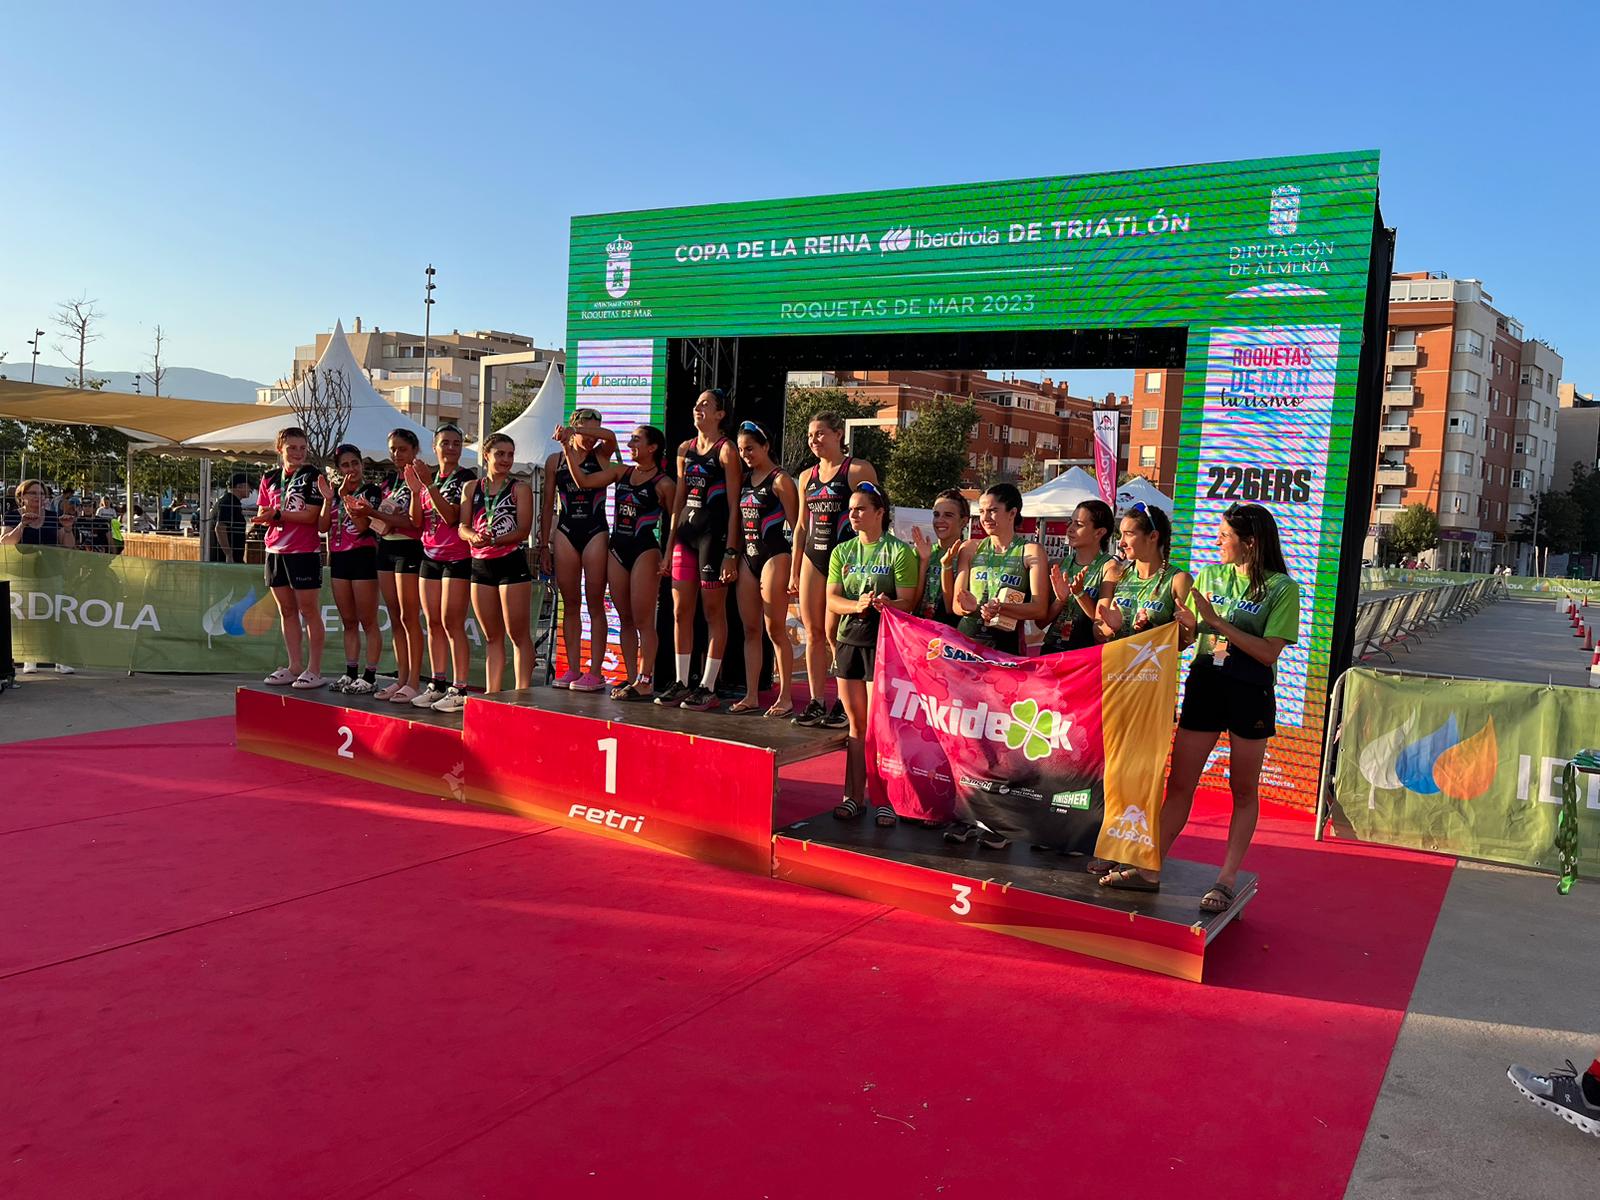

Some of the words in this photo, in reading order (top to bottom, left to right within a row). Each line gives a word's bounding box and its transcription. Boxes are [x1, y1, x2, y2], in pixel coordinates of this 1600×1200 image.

[675, 243, 730, 262] COPA
[736, 240, 765, 259] DE
[770, 238, 797, 257] LA
[804, 233, 871, 255] REINA
[915, 225, 999, 248] Iberdrola
[1008, 222, 1042, 243] DE
[1051, 208, 1190, 240] TRIATLÓN
[1229, 239, 1335, 260] DIPUTACIÓN
[1229, 263, 1250, 276] DE
[1254, 256, 1330, 275] ALMERÍA
[780, 299, 888, 319] ROQUETAS
[894, 298, 922, 315] DE
[928, 296, 975, 314] MAR
[981, 294, 1036, 313] 2023
[1232, 347, 1312, 367] ROQUETAS
[1230, 370, 1257, 393] DE
[1261, 370, 1310, 392] MAR
[1219, 387, 1305, 408] turismo
[1206, 466, 1312, 503] 226ERS
[336, 725, 354, 759] 2
[597, 737, 617, 794] 1
[1052, 792, 1089, 806] FINISHER
[949, 883, 972, 916] 3
